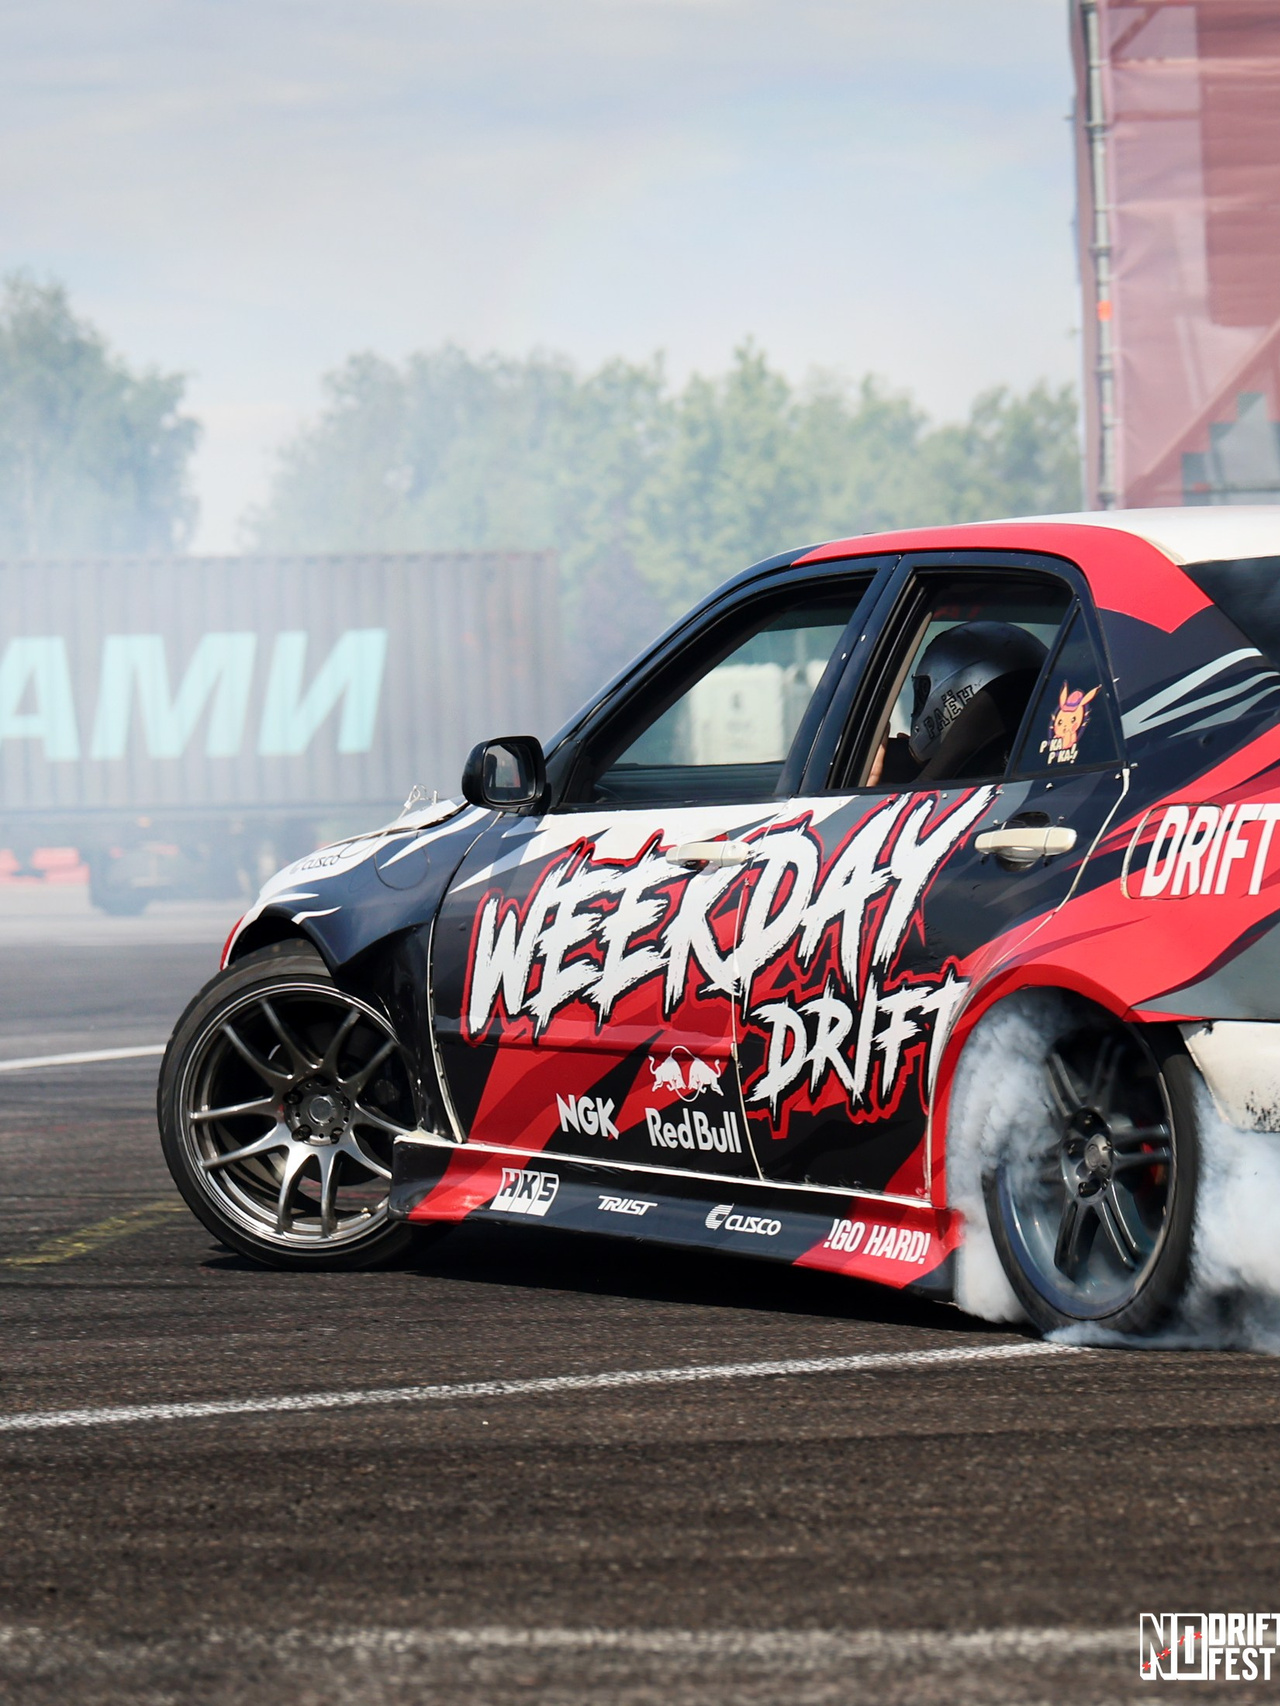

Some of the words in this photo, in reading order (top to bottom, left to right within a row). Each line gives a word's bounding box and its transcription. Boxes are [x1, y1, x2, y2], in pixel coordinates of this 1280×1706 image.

[468, 785, 998, 1037] WEEKDAY
[746, 966, 969, 1118] DRIFT
[556, 1093, 619, 1140] NGK
[645, 1107, 695, 1149] Red
[693, 1110, 742, 1153] Bull
[496, 1168, 559, 1209] HKS
[598, 1195, 657, 1216] TRUST
[724, 1213, 782, 1236] CUSCO
[823, 1218, 866, 1253] !GO
[862, 1225, 931, 1264] HARD!
